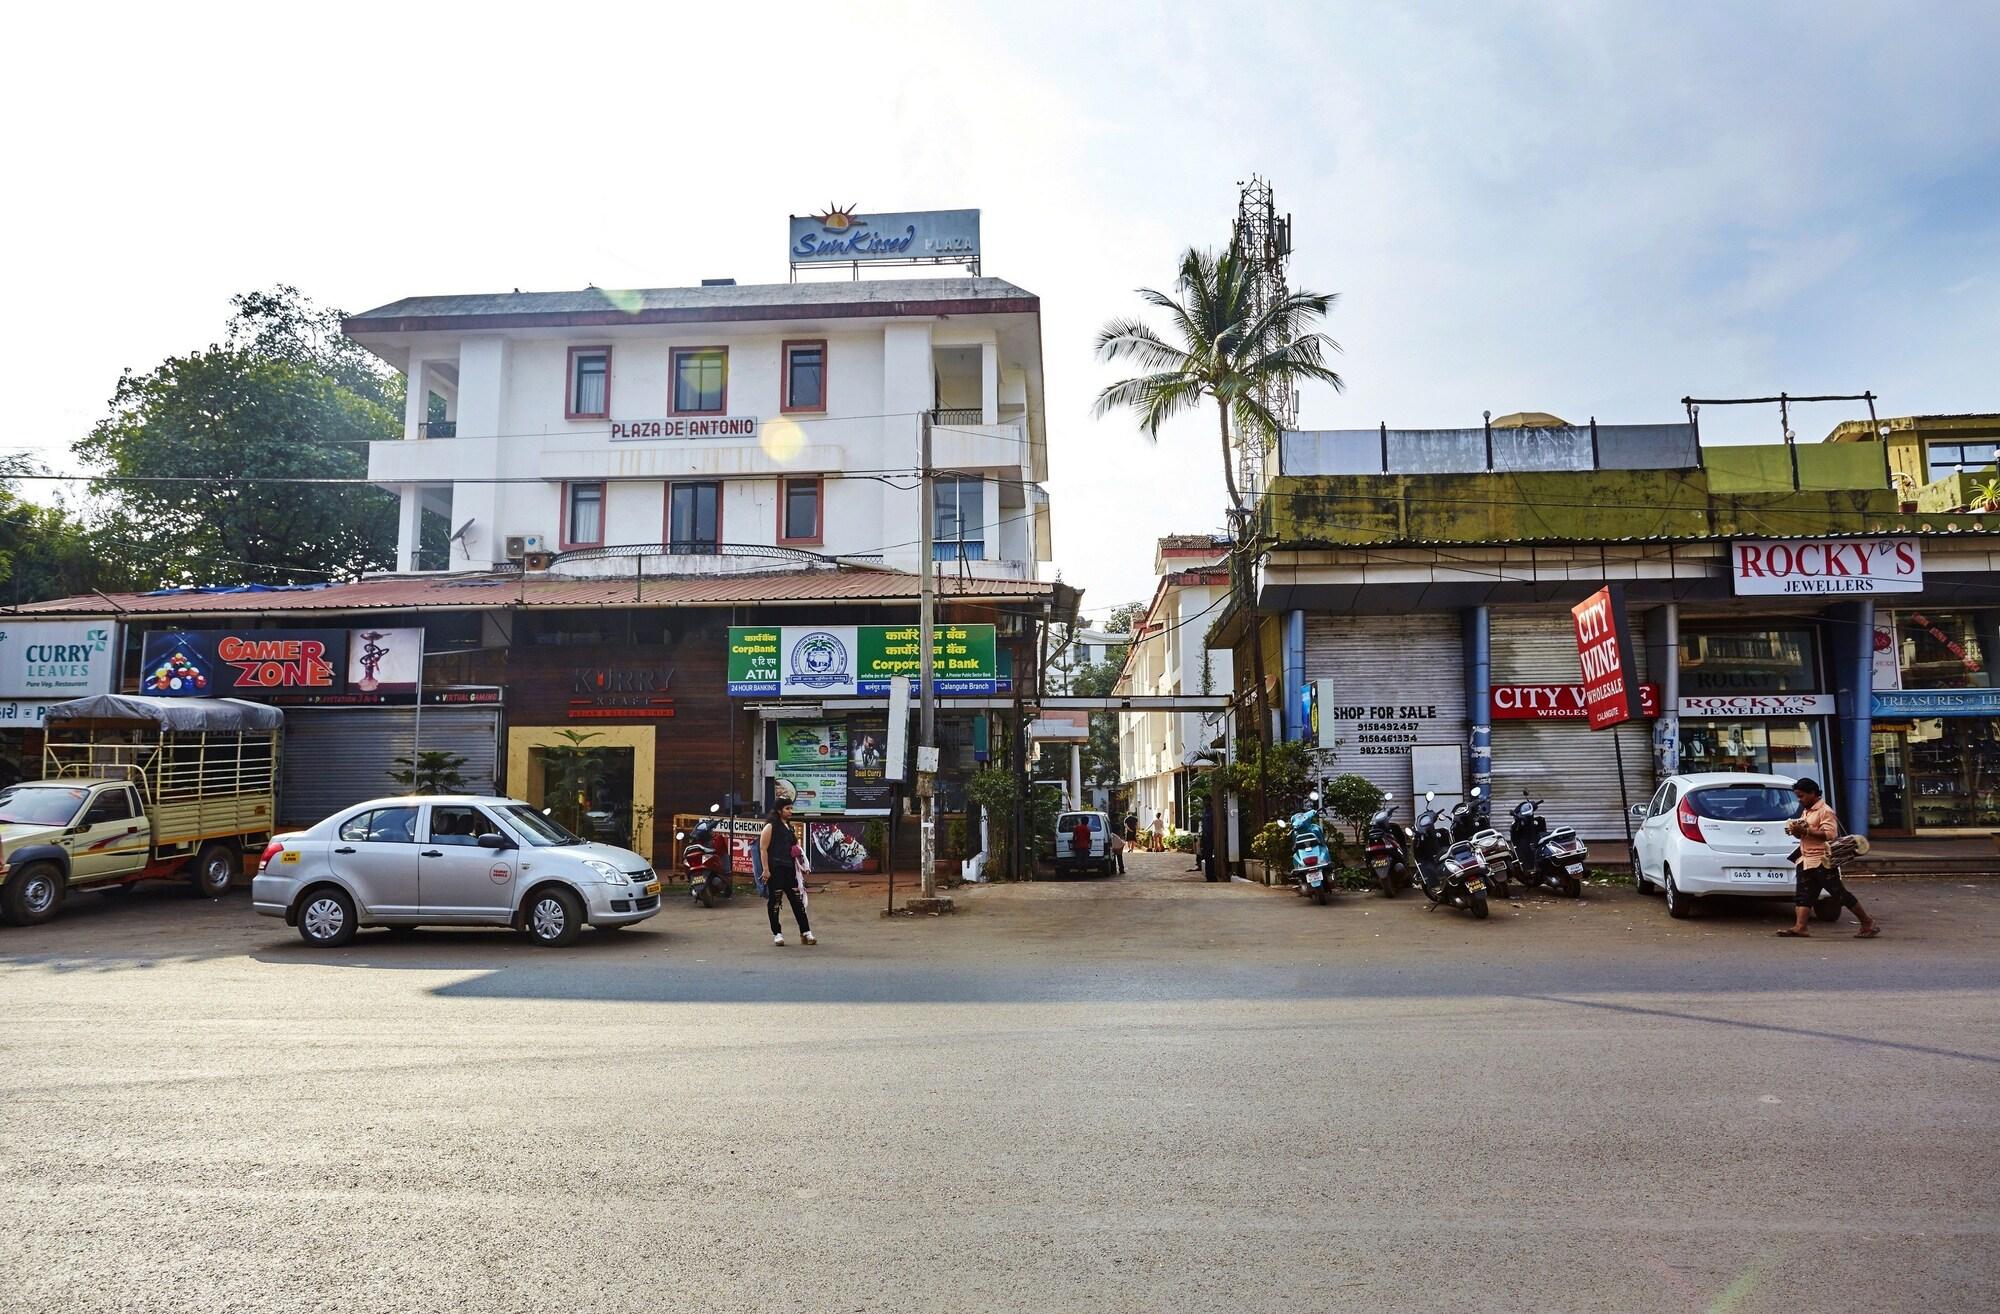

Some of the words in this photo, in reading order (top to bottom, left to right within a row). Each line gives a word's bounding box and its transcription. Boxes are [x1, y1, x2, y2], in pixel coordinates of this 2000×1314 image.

[793, 225, 915, 257] SunKissed
[924, 238, 974, 252] PLAZA
[611, 422, 661, 438] PLAZA
[665, 421, 684, 436] DE
[689, 419, 754, 435] ANTONIO
[1784, 579, 1874, 592] JEWELLERS
[1577, 599, 1609, 644] CITY
[26, 644, 93, 663] CURRY
[218, 636, 332, 677] GAMER
[732, 645, 777, 655] CorpBank
[872, 659, 945, 672] Corporaon
[948, 658, 980, 669] Bank
[1580, 637, 1620, 683] WINE
[28, 664, 89, 677] LEAVES
[226, 661, 335, 687] ZONE
[745, 669, 777, 680] ATM
[574, 668, 676, 693] KURRY
[940, 682, 968, 691] Calangute
[968, 682, 989, 690] Branch
[1494, 687, 1562, 709] CITY
[1586, 678, 1624, 705] WHOLESALE
[1881, 695, 1963, 706] TREASURES
[1334, 706, 1364, 719] SHOP
[1370, 706, 1394, 719] FOR
[1399, 705, 1437, 719] SALE
[1596, 706, 1619, 721] CALANGUTE
[1700, 707, 1805, 715] JEWELLERS
[1357, 722, 1419, 731] 9158492457
[1360, 746, 1411, 754] 982258217
[734, 821, 766, 832] CHECKIN
